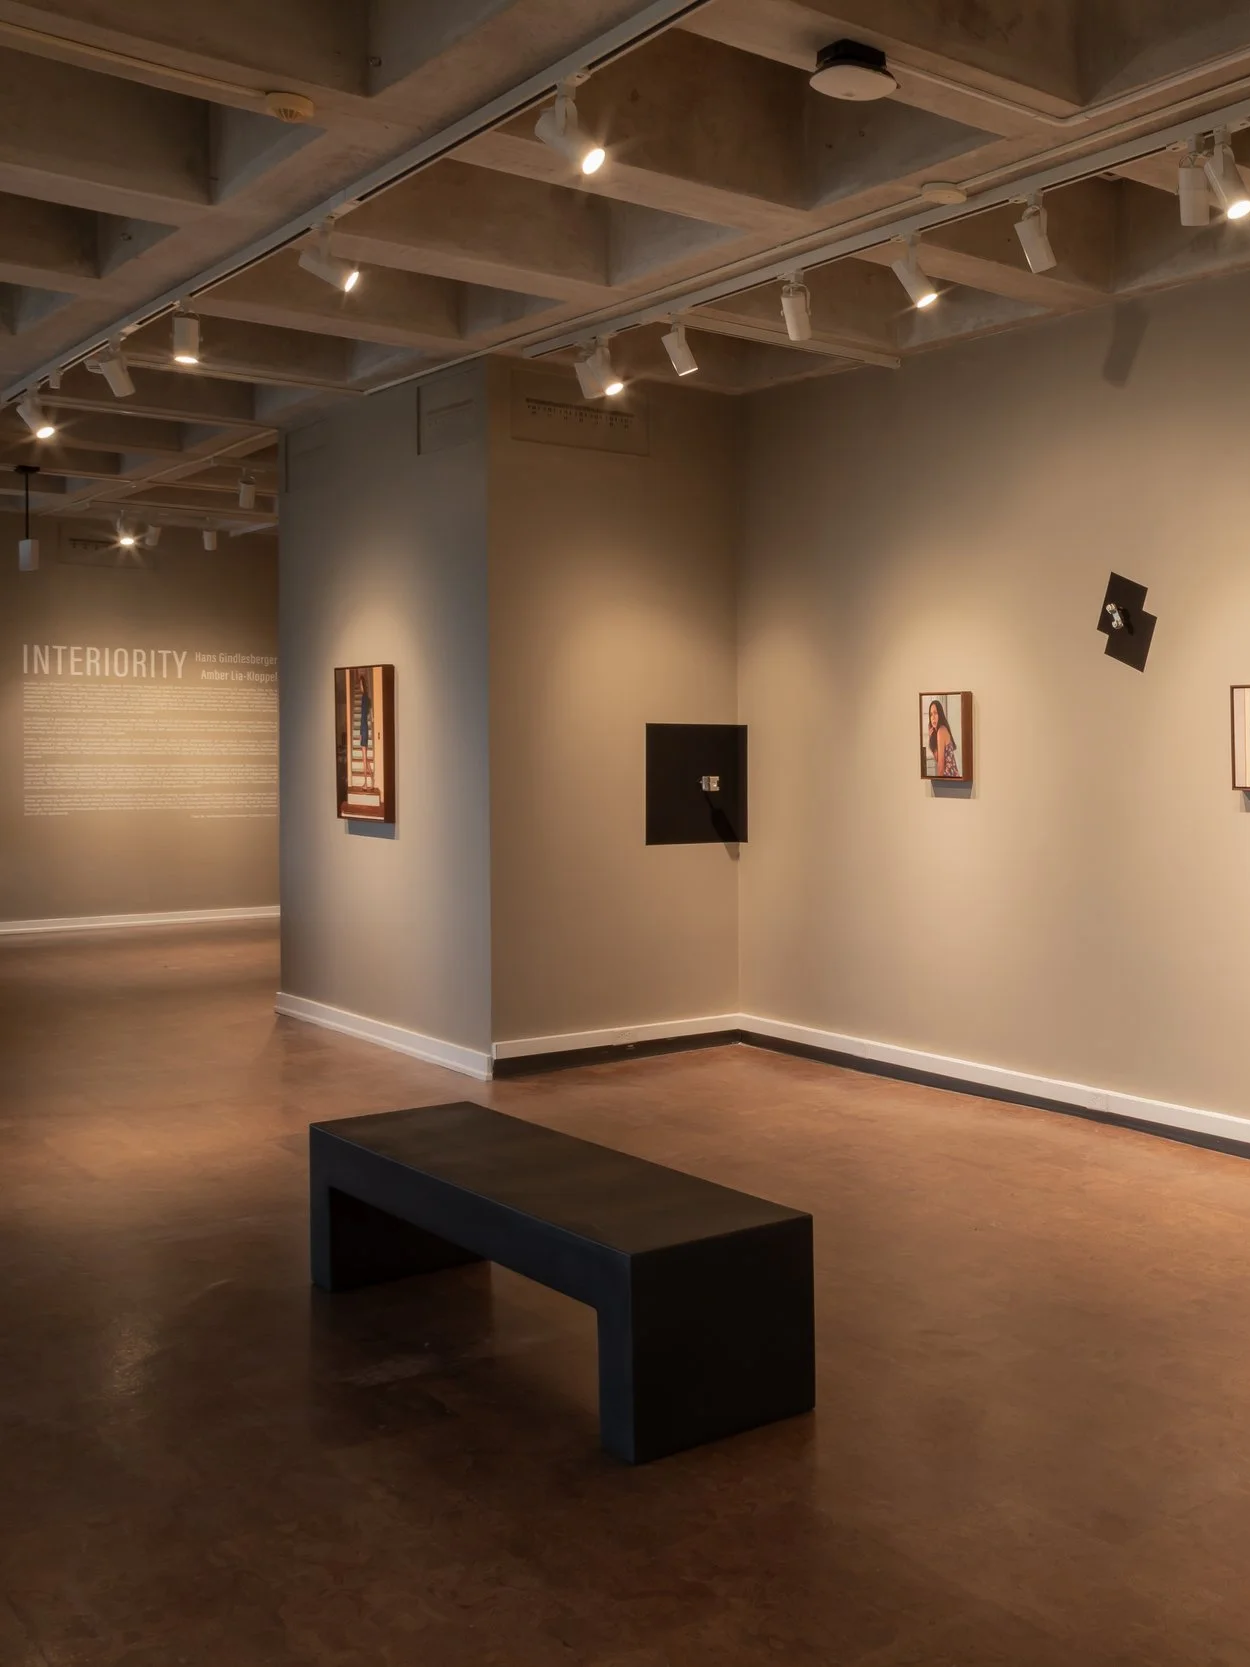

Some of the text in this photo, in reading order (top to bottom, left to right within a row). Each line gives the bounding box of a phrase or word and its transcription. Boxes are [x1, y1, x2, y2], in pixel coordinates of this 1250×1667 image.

[23, 644, 188, 679] INTERIORITY
[195, 651, 278, 666] Hans Gindlesberger
[201, 669, 229, 681] Amber
